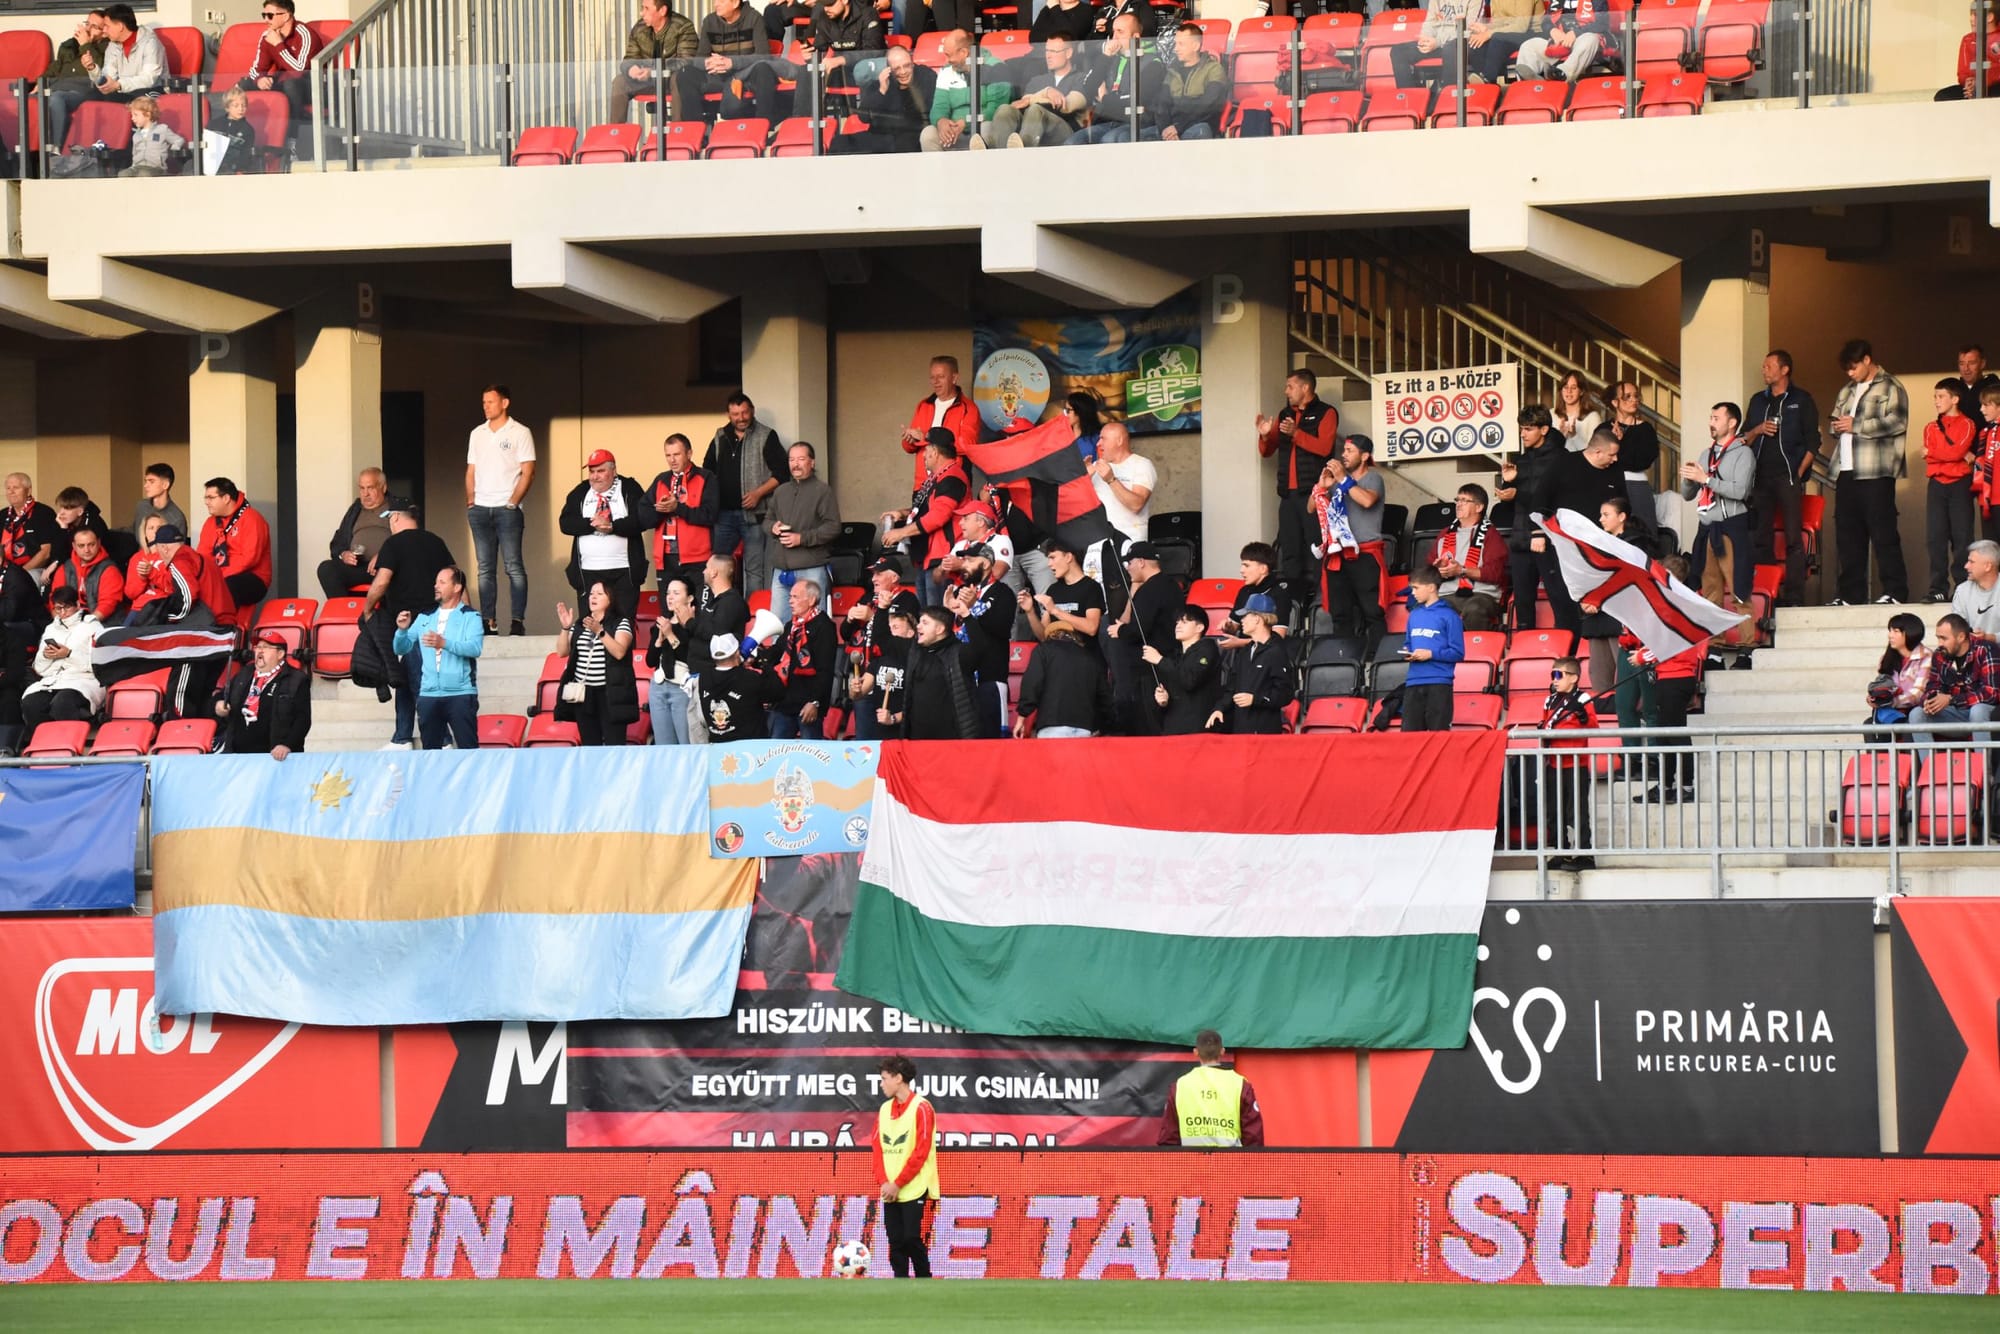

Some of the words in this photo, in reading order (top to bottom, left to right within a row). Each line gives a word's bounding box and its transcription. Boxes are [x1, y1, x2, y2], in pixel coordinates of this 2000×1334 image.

[1751, 228, 1764, 267] B
[358, 282, 374, 319] B
[1212, 274, 1244, 324] B
[1385, 380, 1401, 395] Ez
[1406, 378, 1422, 393] itt
[1426, 381, 1435, 392] a
[1440, 369, 1501, 391] B-KÖZÉP
[1385, 400, 1395, 425] NEM
[1387, 431, 1397, 458] IGEN
[737, 1001, 872, 1035] HISZÜNK
[1635, 1002, 1834, 1043] PRIMĂRIA
[1637, 1055, 1838, 1073] MIERCUREA-CIUC
[691, 1069, 790, 1097] EGYÜTT
[796, 1073, 857, 1096] MEG
[975, 1072, 1099, 1100] CSINÁLNI!
[1200, 1090, 1218, 1100] 151
[1185, 1116, 1235, 1129] GOMBOS
[306, 1195, 381, 1280] E
[400, 1170, 514, 1280] ÎN
[1026, 1194, 1300, 1282] TALE
[1440, 1171, 2000, 1295] SUPERB
